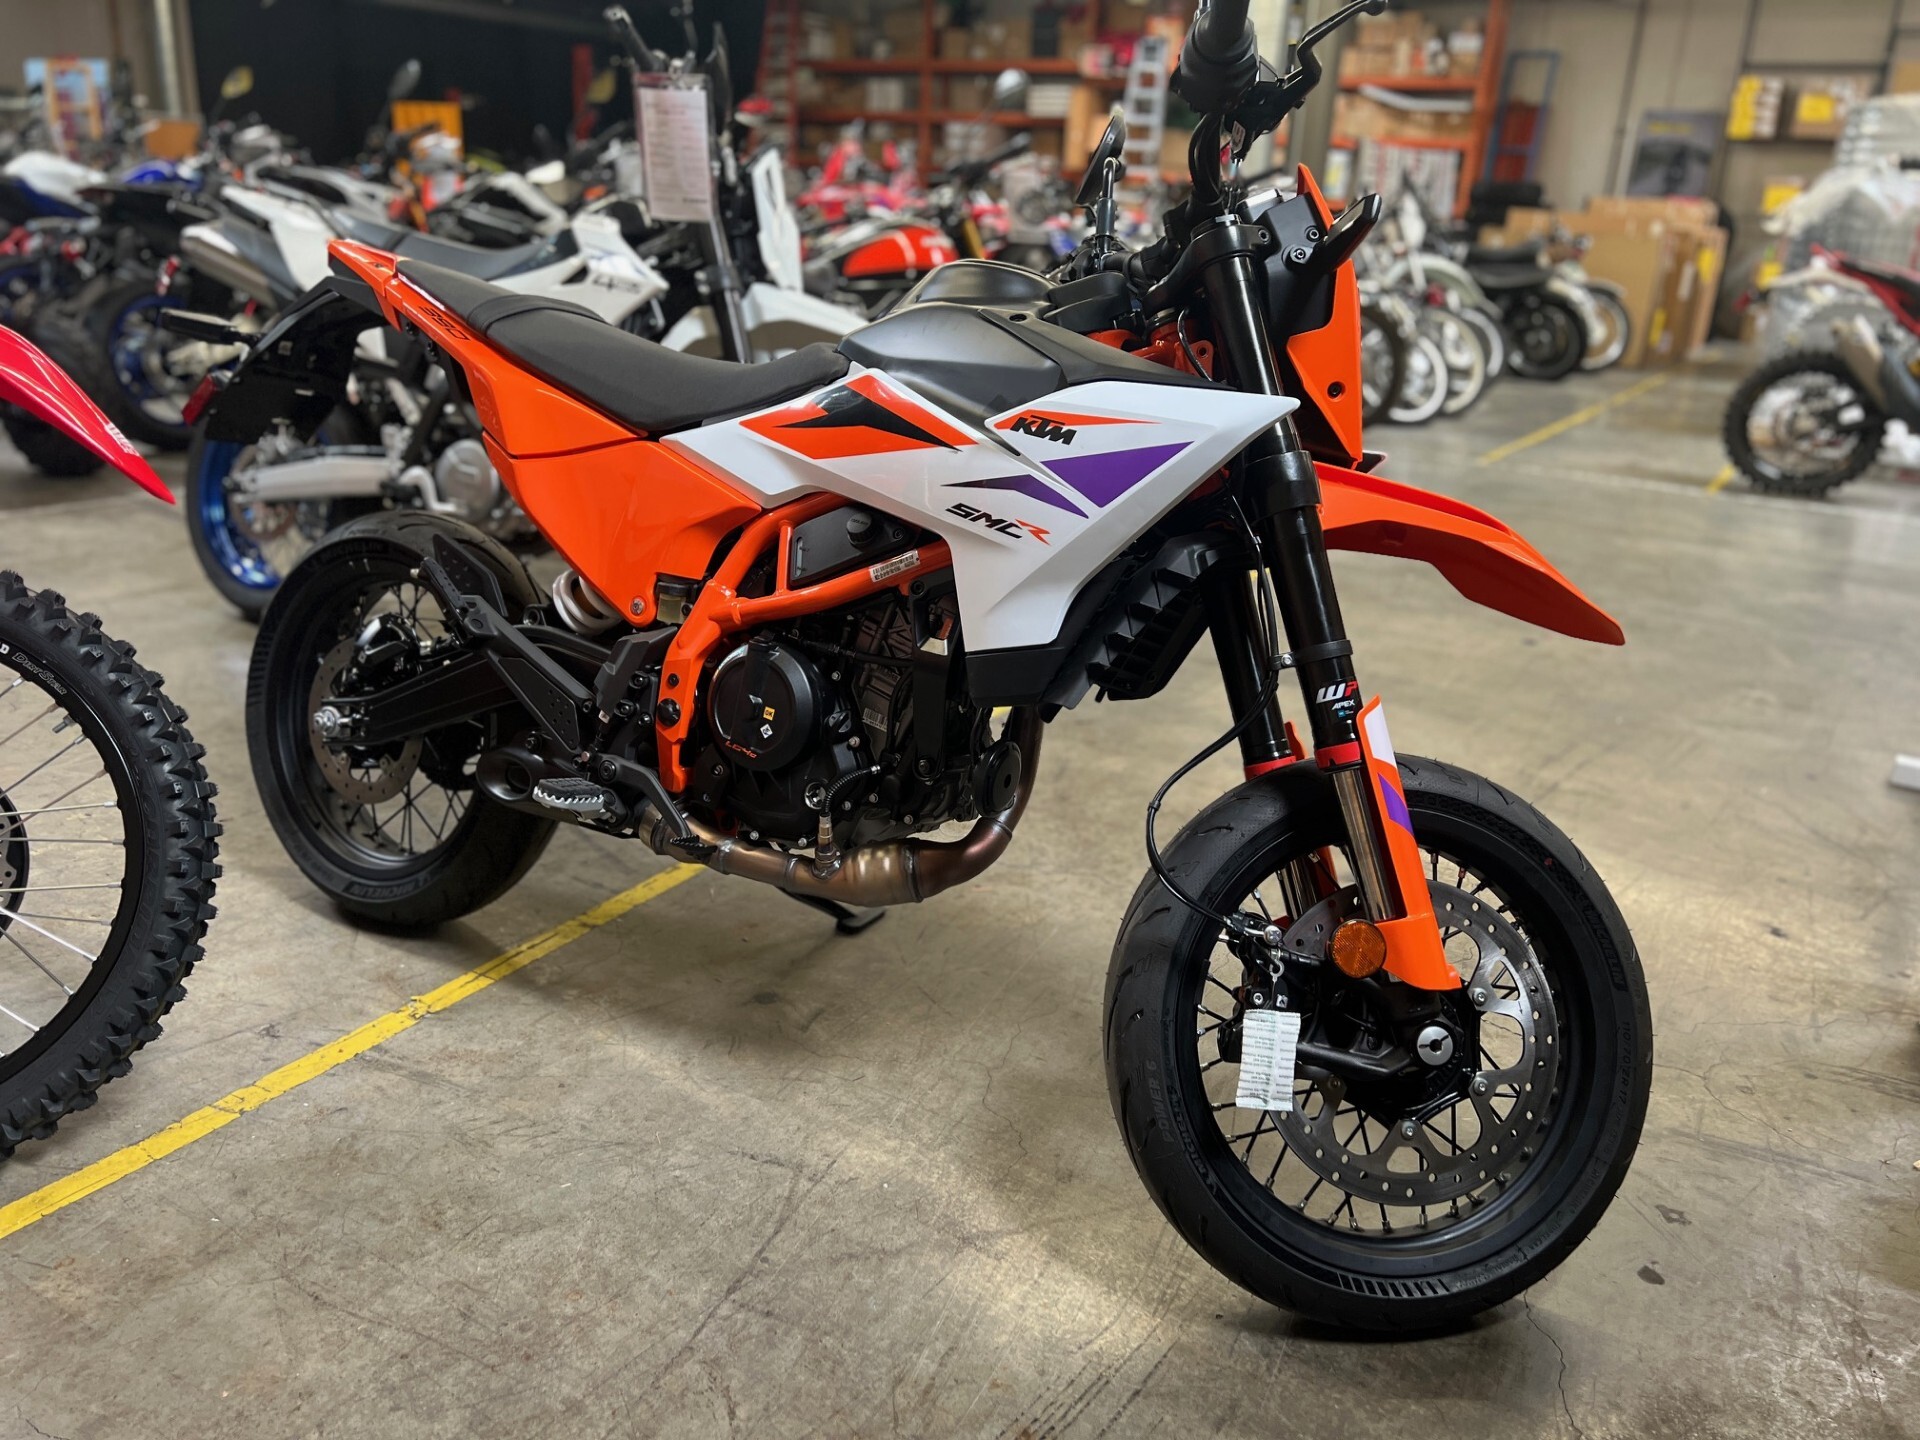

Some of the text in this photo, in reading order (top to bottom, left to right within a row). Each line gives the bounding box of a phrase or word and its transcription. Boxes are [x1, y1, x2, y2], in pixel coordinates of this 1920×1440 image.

[419, 306, 471, 341] 350
[1010, 415, 1077, 446] KTM
[1316, 681, 1358, 704] WP
[1331, 699, 1356, 711] APEX
[1145, 1059, 1175, 1143] POWER 6
